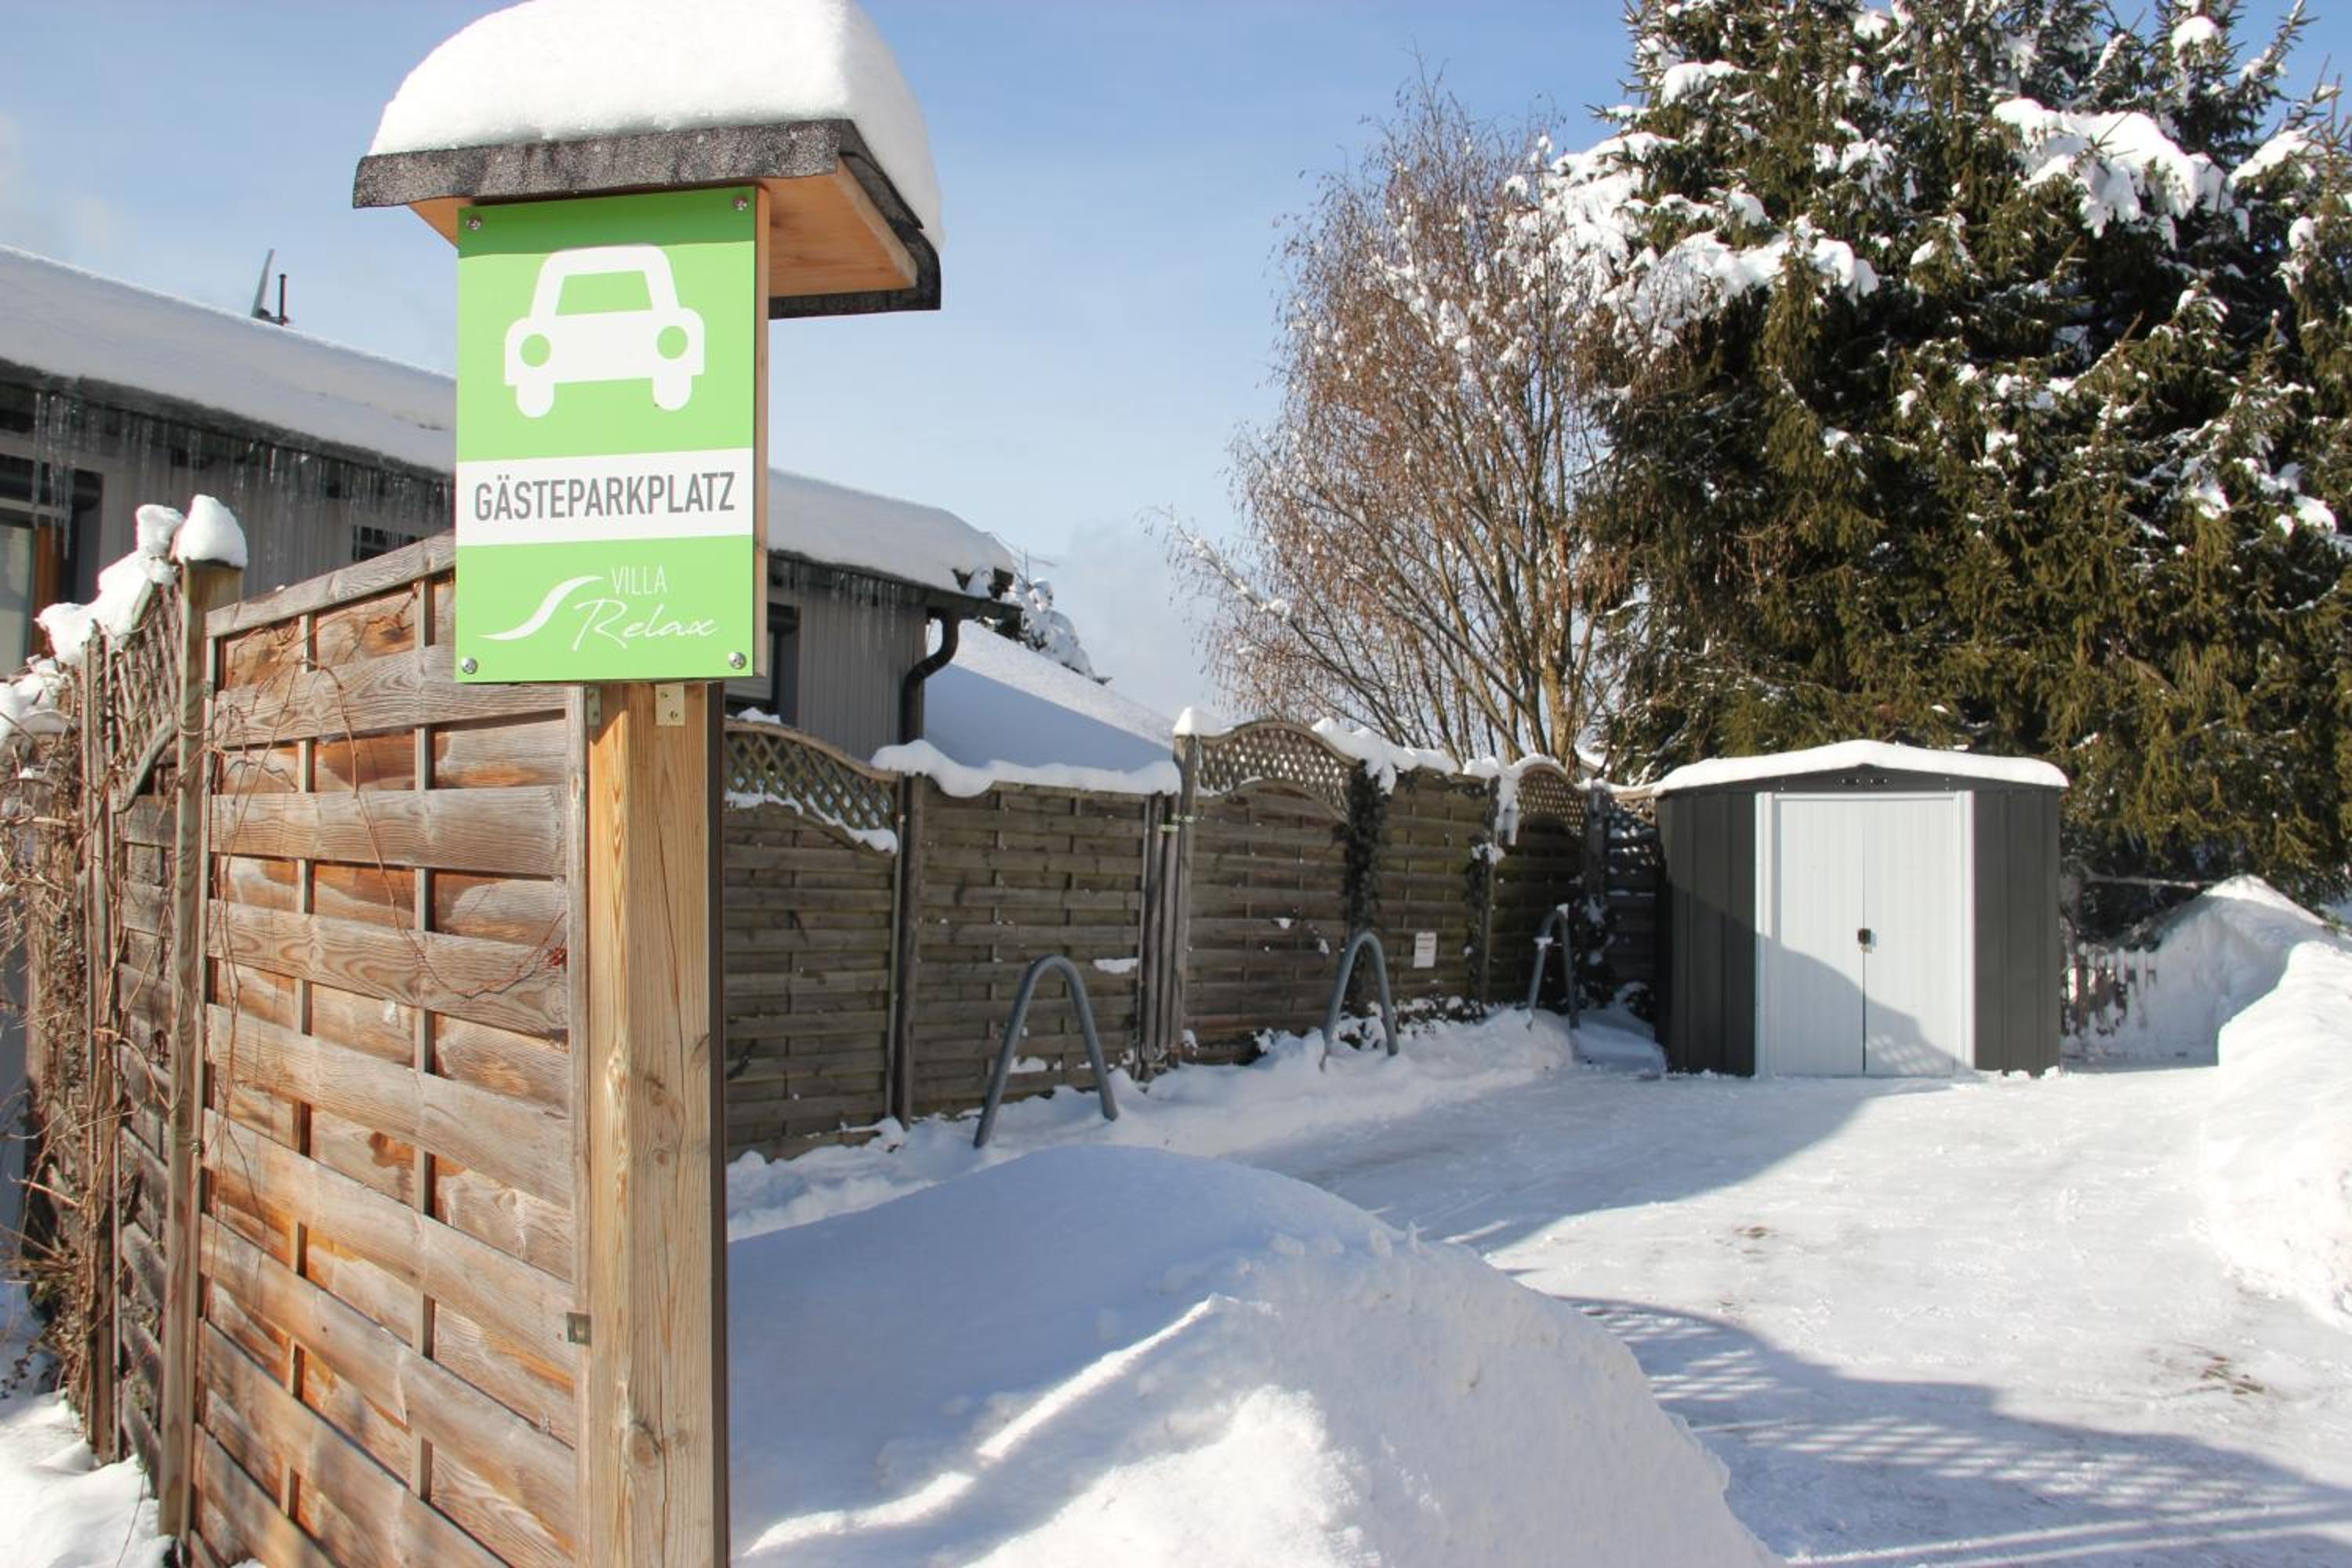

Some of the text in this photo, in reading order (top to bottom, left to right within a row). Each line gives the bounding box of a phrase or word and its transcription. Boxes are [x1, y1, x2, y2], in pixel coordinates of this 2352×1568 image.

[474, 471, 735, 521] GÄSTEPARKPLATZ
[611, 564, 667, 596] VILLA
[572, 597, 717, 652] Relax
